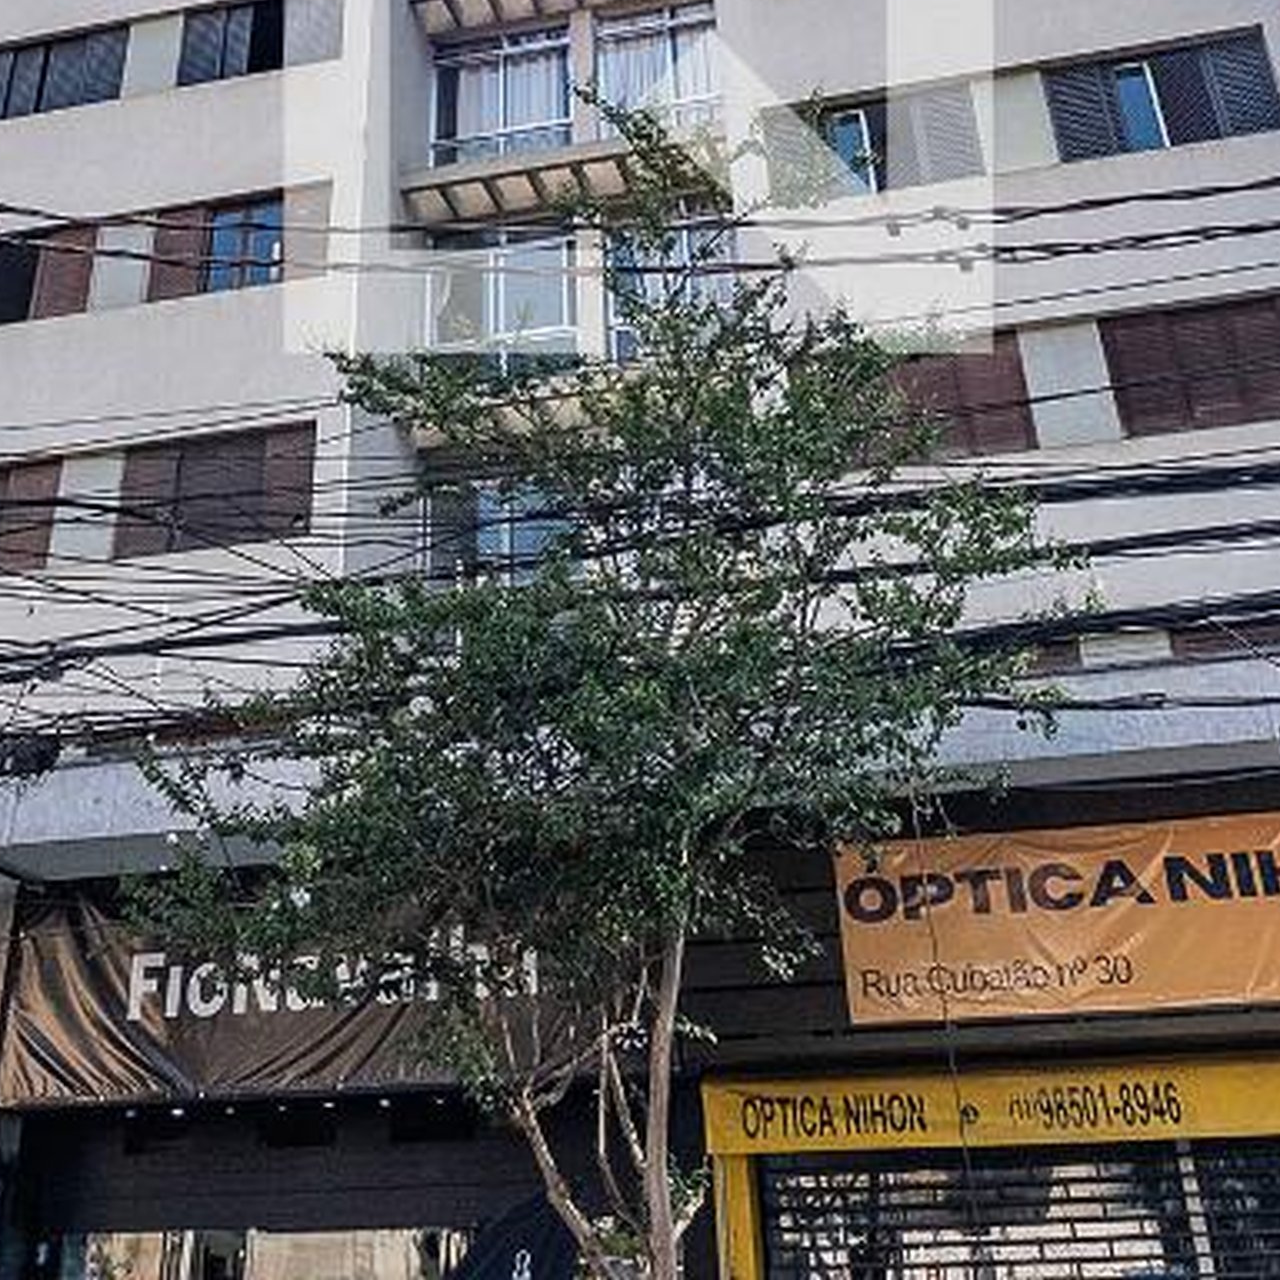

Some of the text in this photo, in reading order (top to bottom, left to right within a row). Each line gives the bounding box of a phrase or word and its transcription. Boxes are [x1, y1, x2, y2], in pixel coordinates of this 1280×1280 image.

[861, 969, 921, 998] Rua
[1093, 954, 1134, 985] 30
[843, 1093, 928, 1136] NIHON
